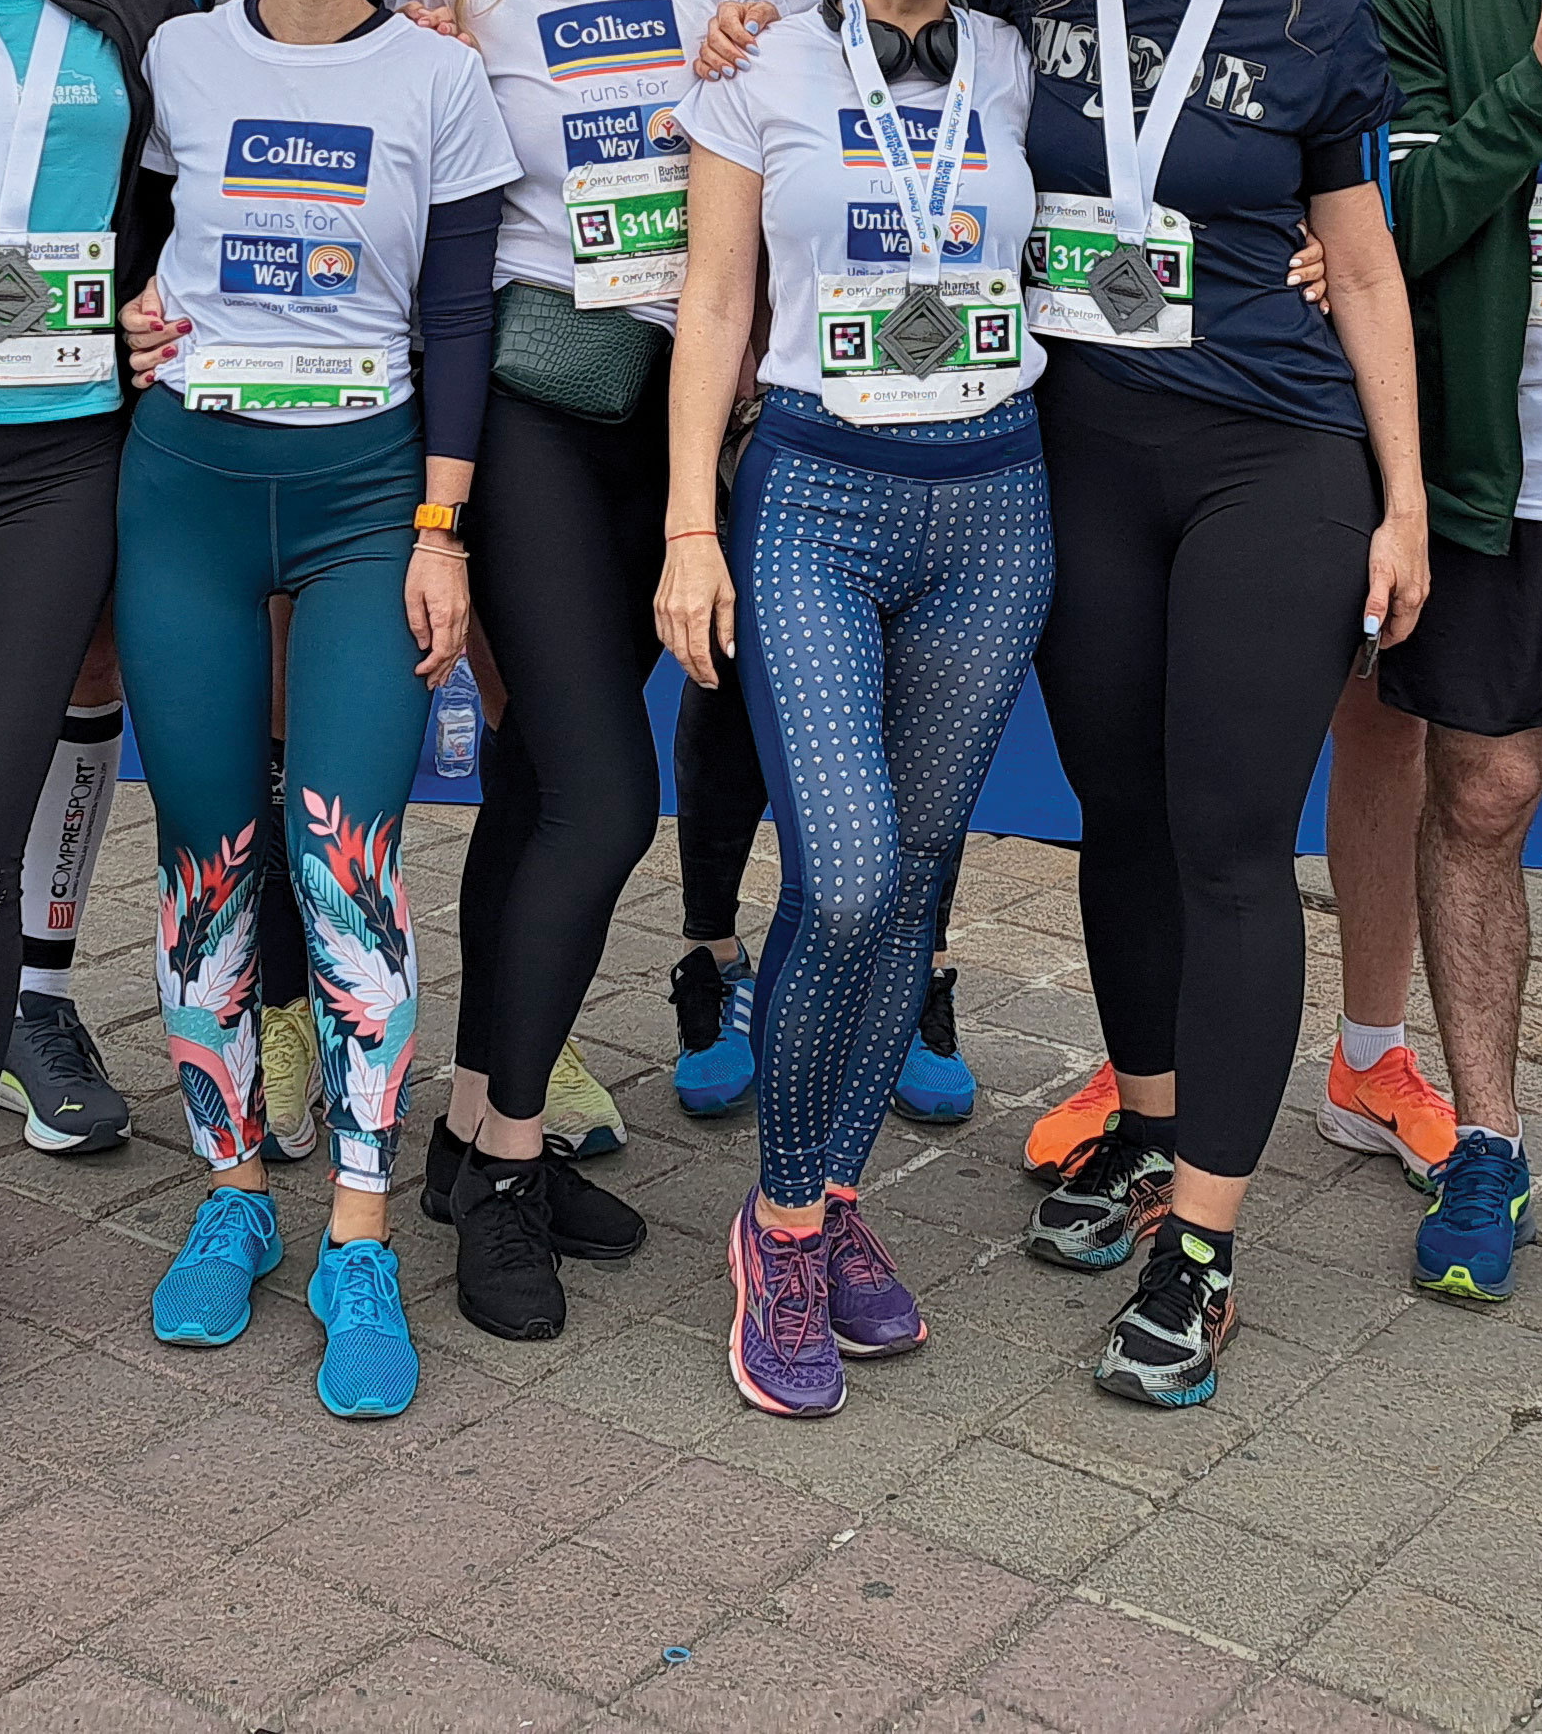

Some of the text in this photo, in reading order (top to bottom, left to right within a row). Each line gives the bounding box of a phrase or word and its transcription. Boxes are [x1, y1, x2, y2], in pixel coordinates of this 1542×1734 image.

[554, 15, 666, 49] Colliers
[580, 78, 669, 105] runs for
[1206, 53, 1266, 120] IT.
[566, 111, 639, 141] United
[242, 135, 356, 169] Colliers
[597, 136, 640, 161] Way
[590, 173, 649, 187] OMV Petrom
[245, 210, 339, 231] runs for
[225, 240, 298, 264] United
[880, 232, 911, 254] Wa
[254, 263, 298, 292] Way
[847, 287, 872, 296] OMV
[288, 303, 338, 314] Romania
[218, 358, 284, 368] OMV Petrom
[297, 355, 352, 367] Bucharest
[874, 390, 937, 401] OMV Petrom
